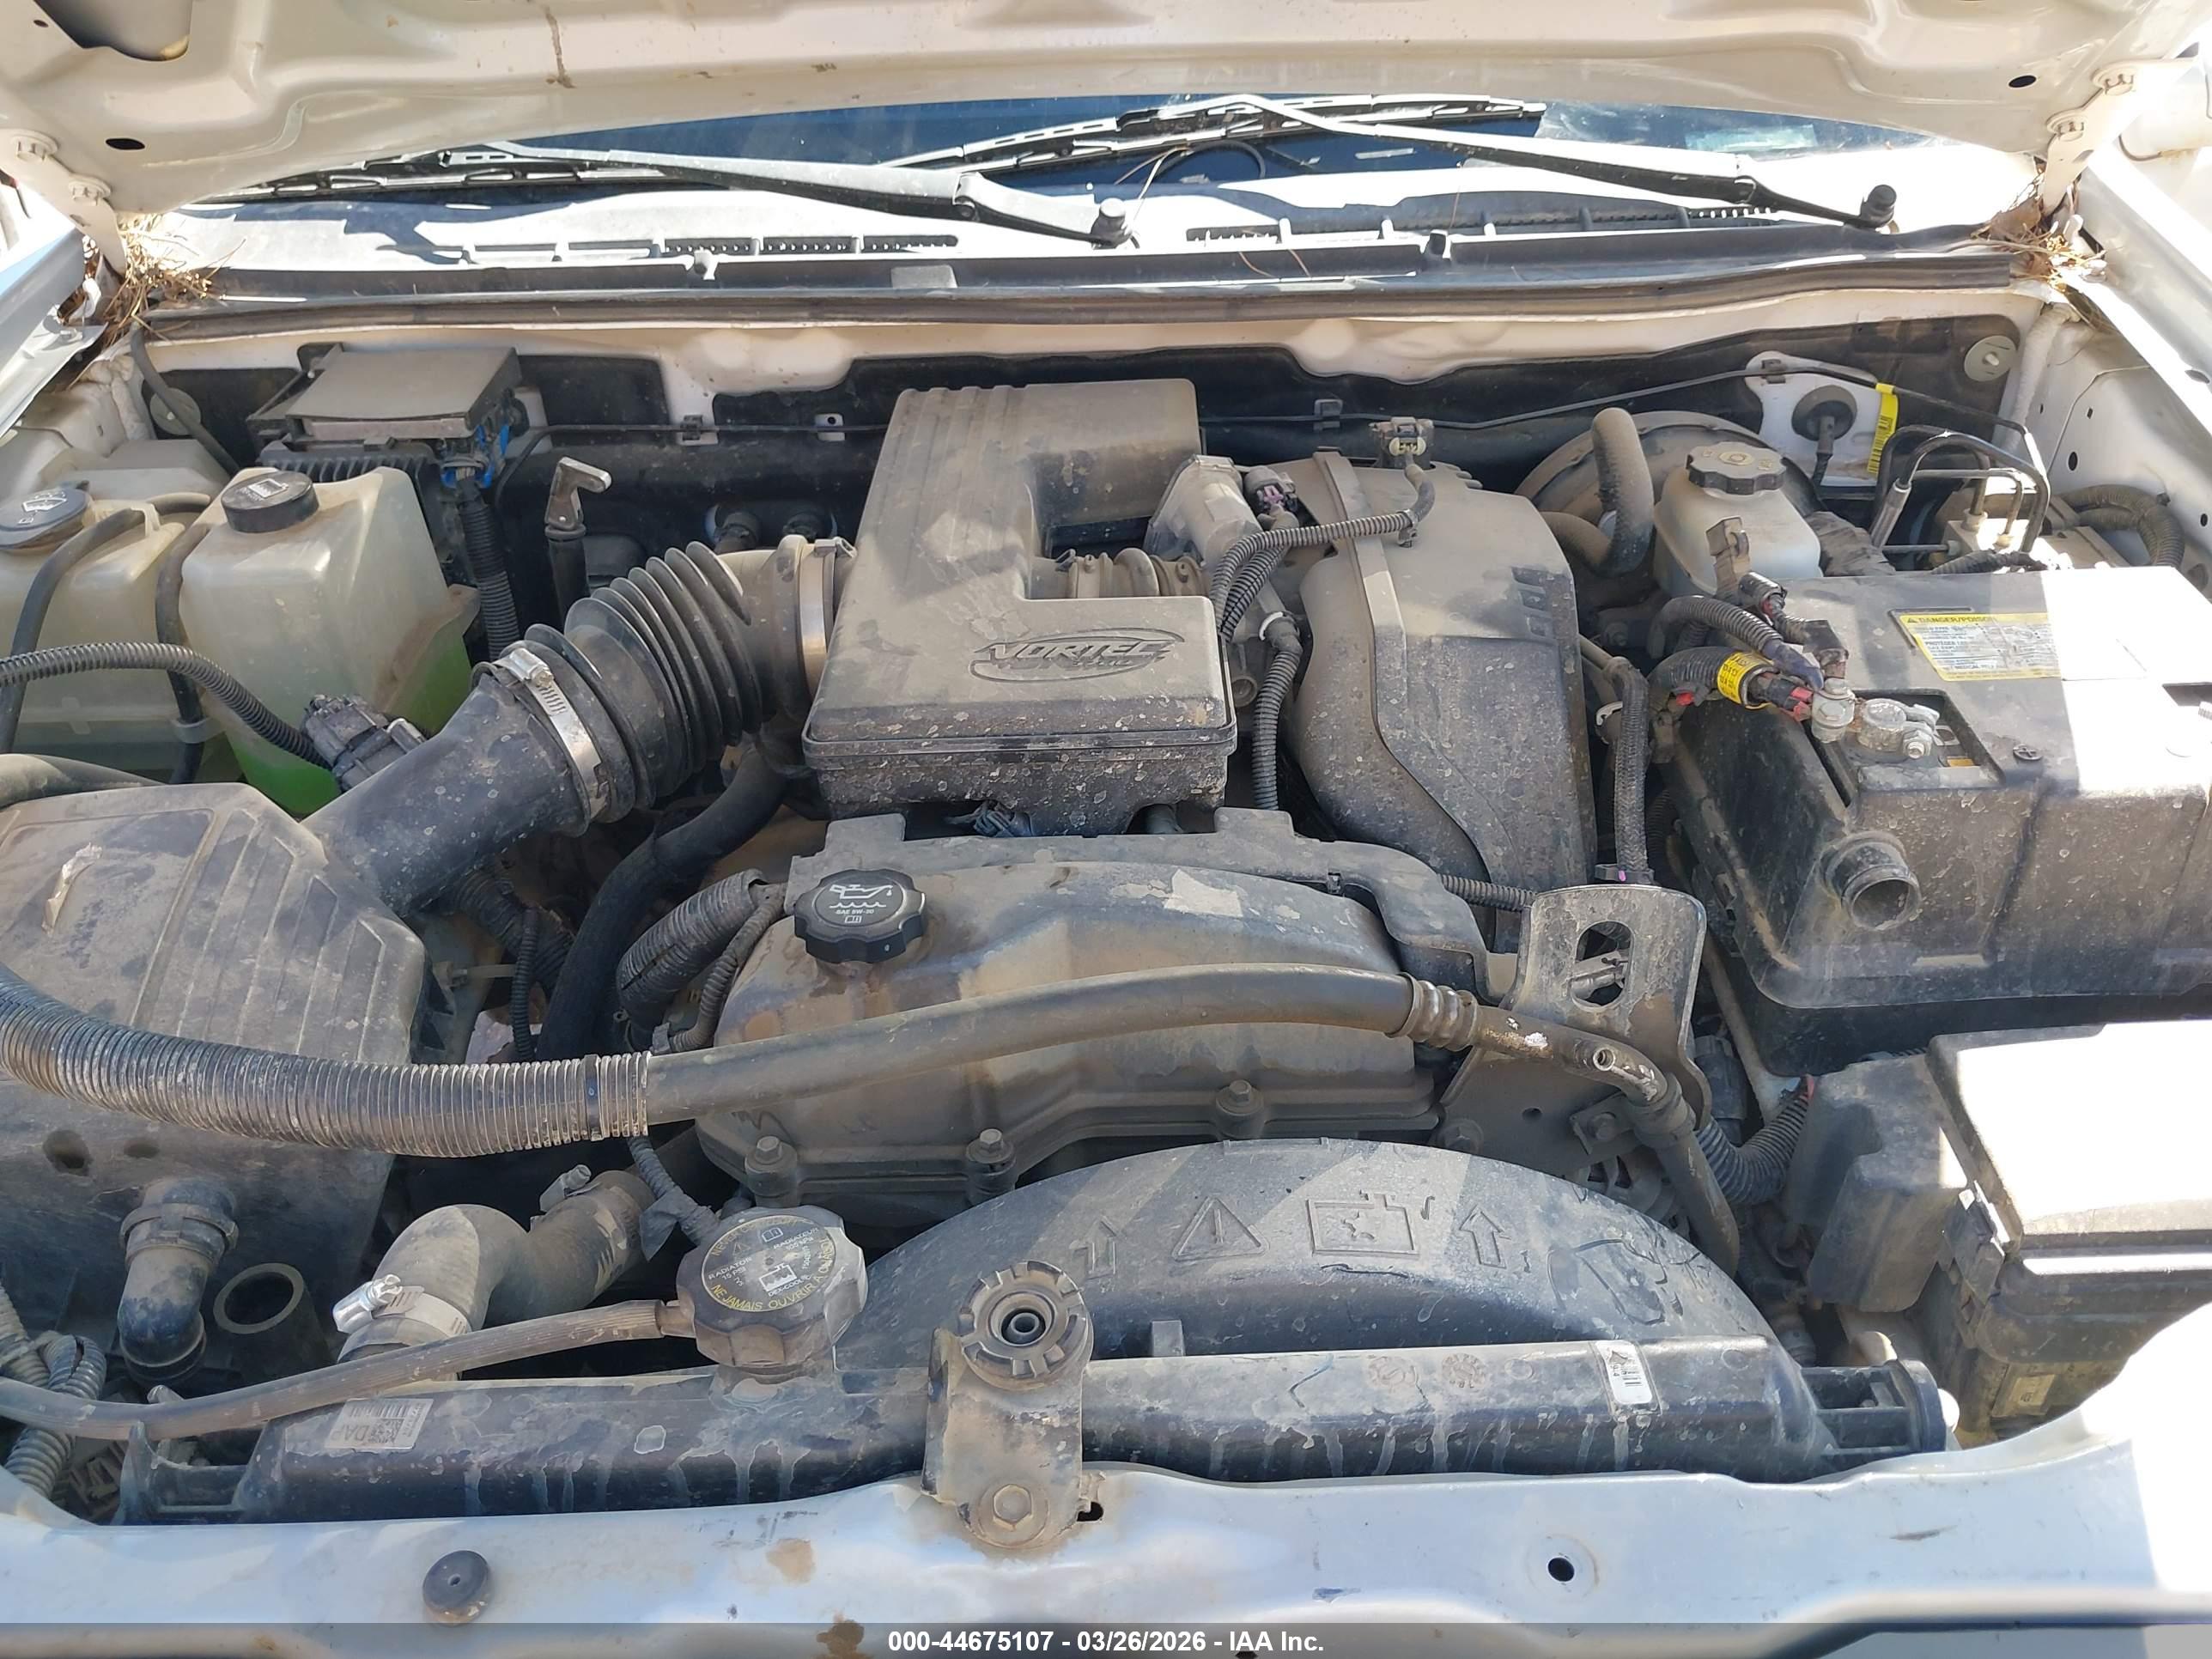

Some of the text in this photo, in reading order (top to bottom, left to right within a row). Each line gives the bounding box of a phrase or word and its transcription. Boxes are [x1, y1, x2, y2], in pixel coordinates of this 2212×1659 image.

[989, 641, 1175, 659] VORTEC
[711, 1231, 741, 1256] NEVER
[773, 1227, 819, 1249] RADIATEUR
[708, 1256, 752, 1280] RADIATOR
[710, 1284, 726, 1300] NE
[722, 1294, 763, 1310] JAMAIS
[769, 1282, 815, 1310] OUVRIR
